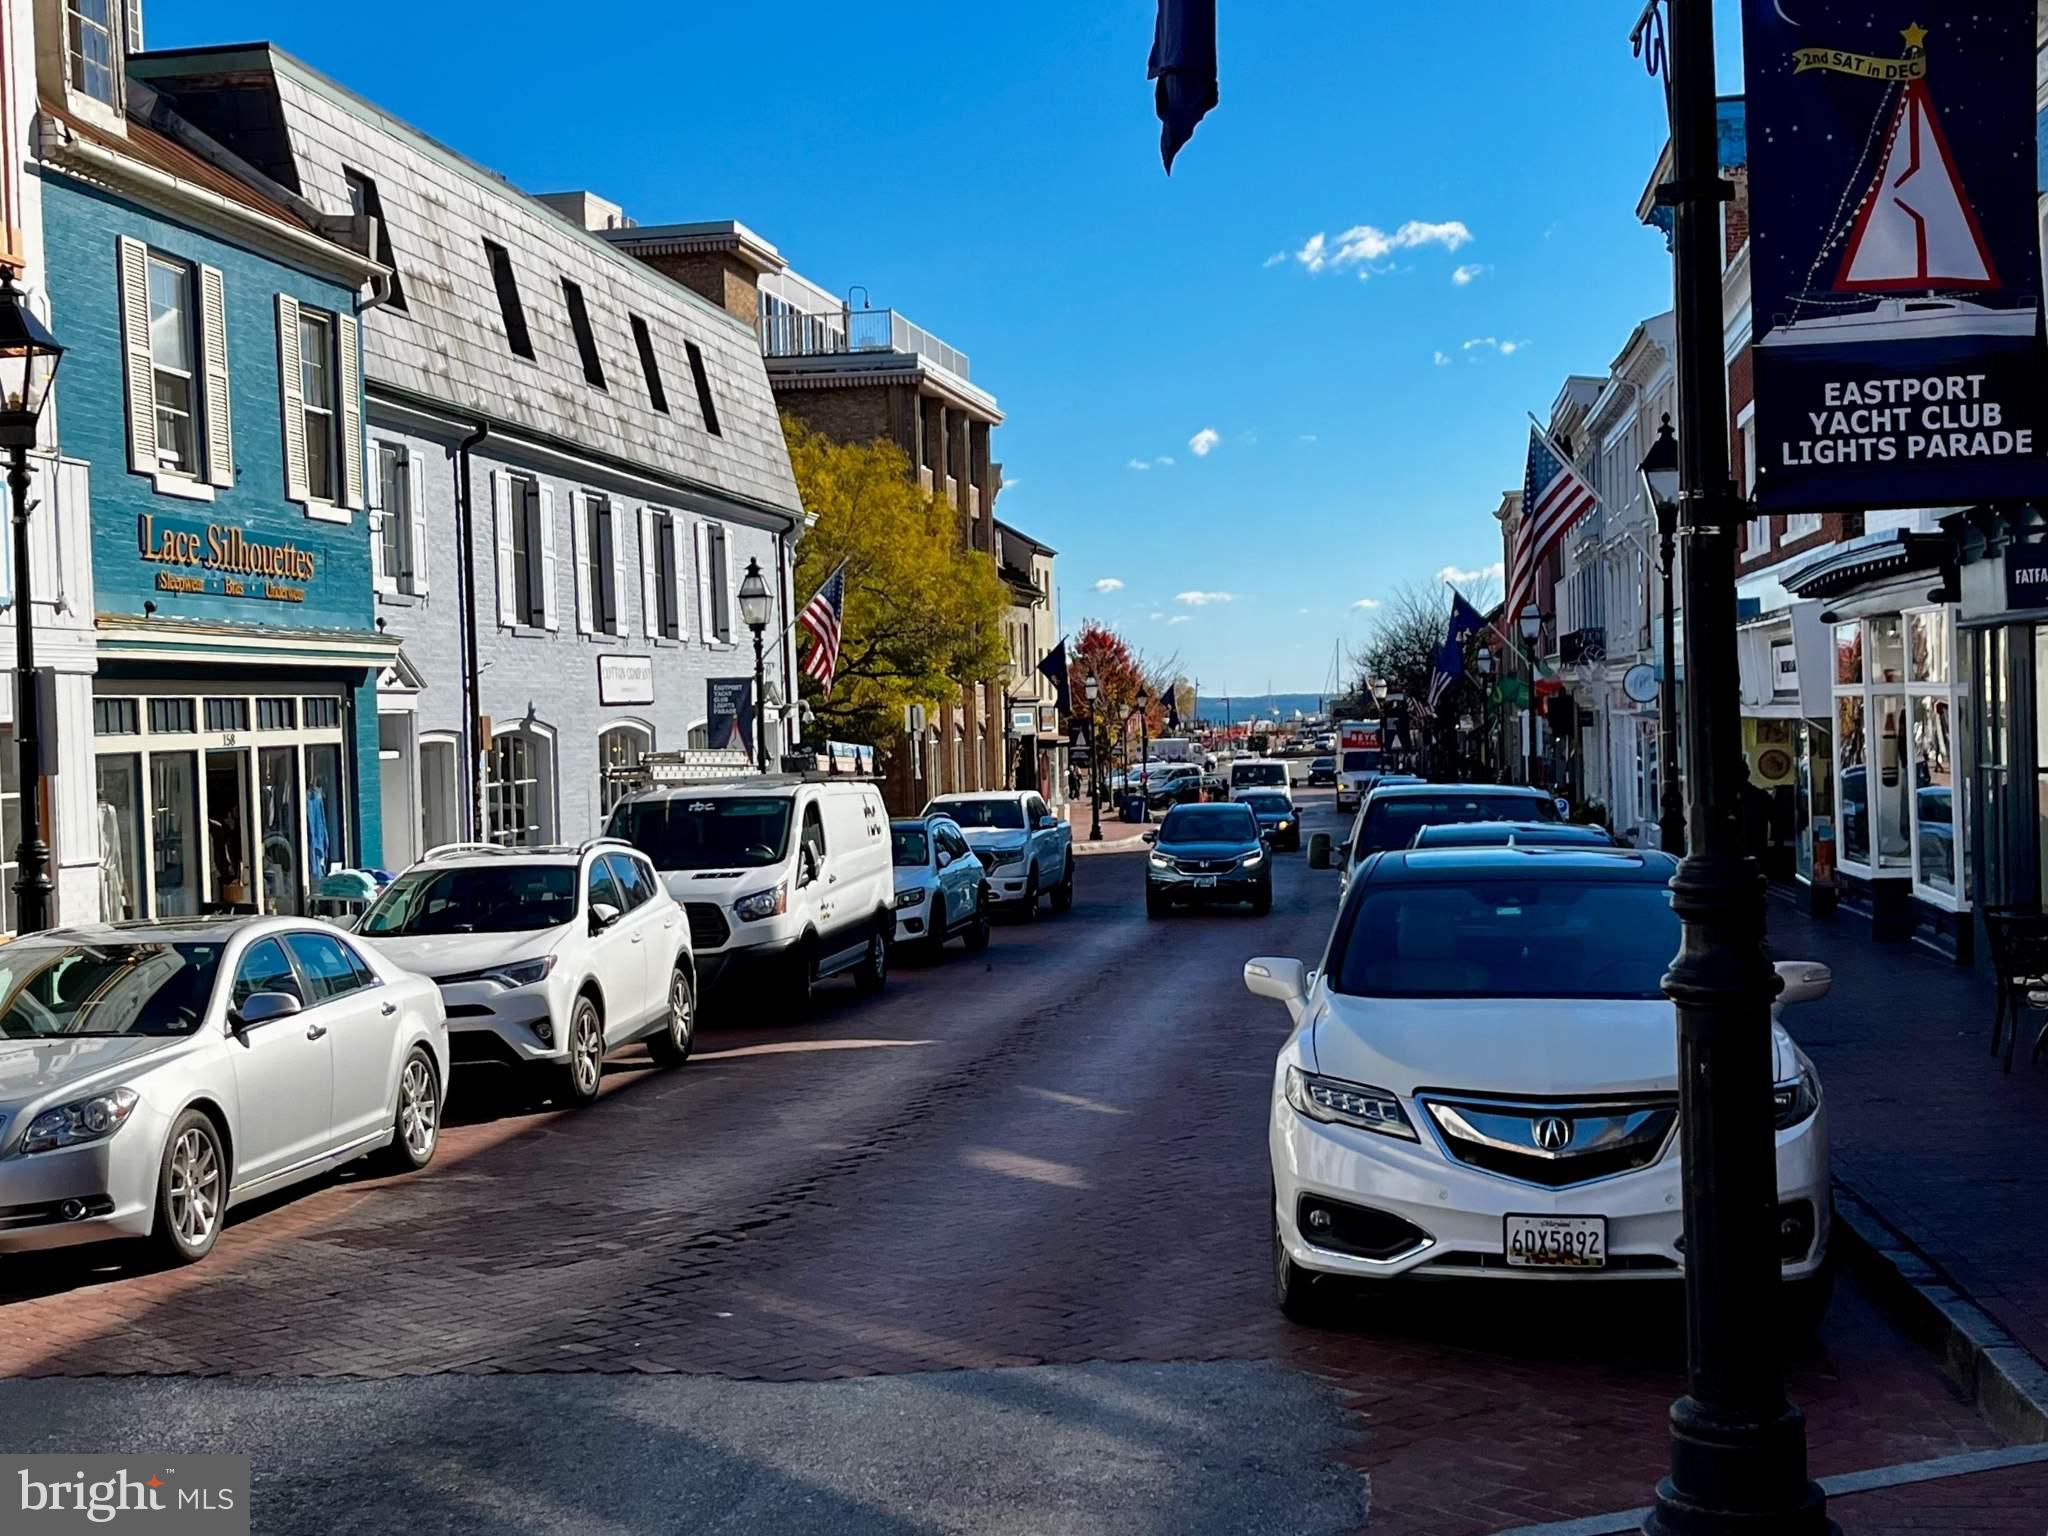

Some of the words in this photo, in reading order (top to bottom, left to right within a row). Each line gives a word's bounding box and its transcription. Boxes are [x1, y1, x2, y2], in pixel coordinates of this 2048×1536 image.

[1803, 52, 1829, 66] 2nd
[1832, 53, 1864, 71] SAT
[1867, 62, 1880, 77] in
[1885, 62, 1920, 78] DEC
[1824, 374, 1986, 406] EASTPORT
[1808, 407, 1912, 435] YACHT
[1921, 403, 2002, 430] CLUB
[1782, 437, 1897, 465] LIGHTS
[1907, 429, 2033, 459] PARADE
[143, 513, 200, 564] Lace
[204, 523, 315, 580] Silhouettes
[225, 576, 244, 595] Bras
[223, 733, 236, 746] 158
[1512, 1230, 1600, 1259] 6DX5892
